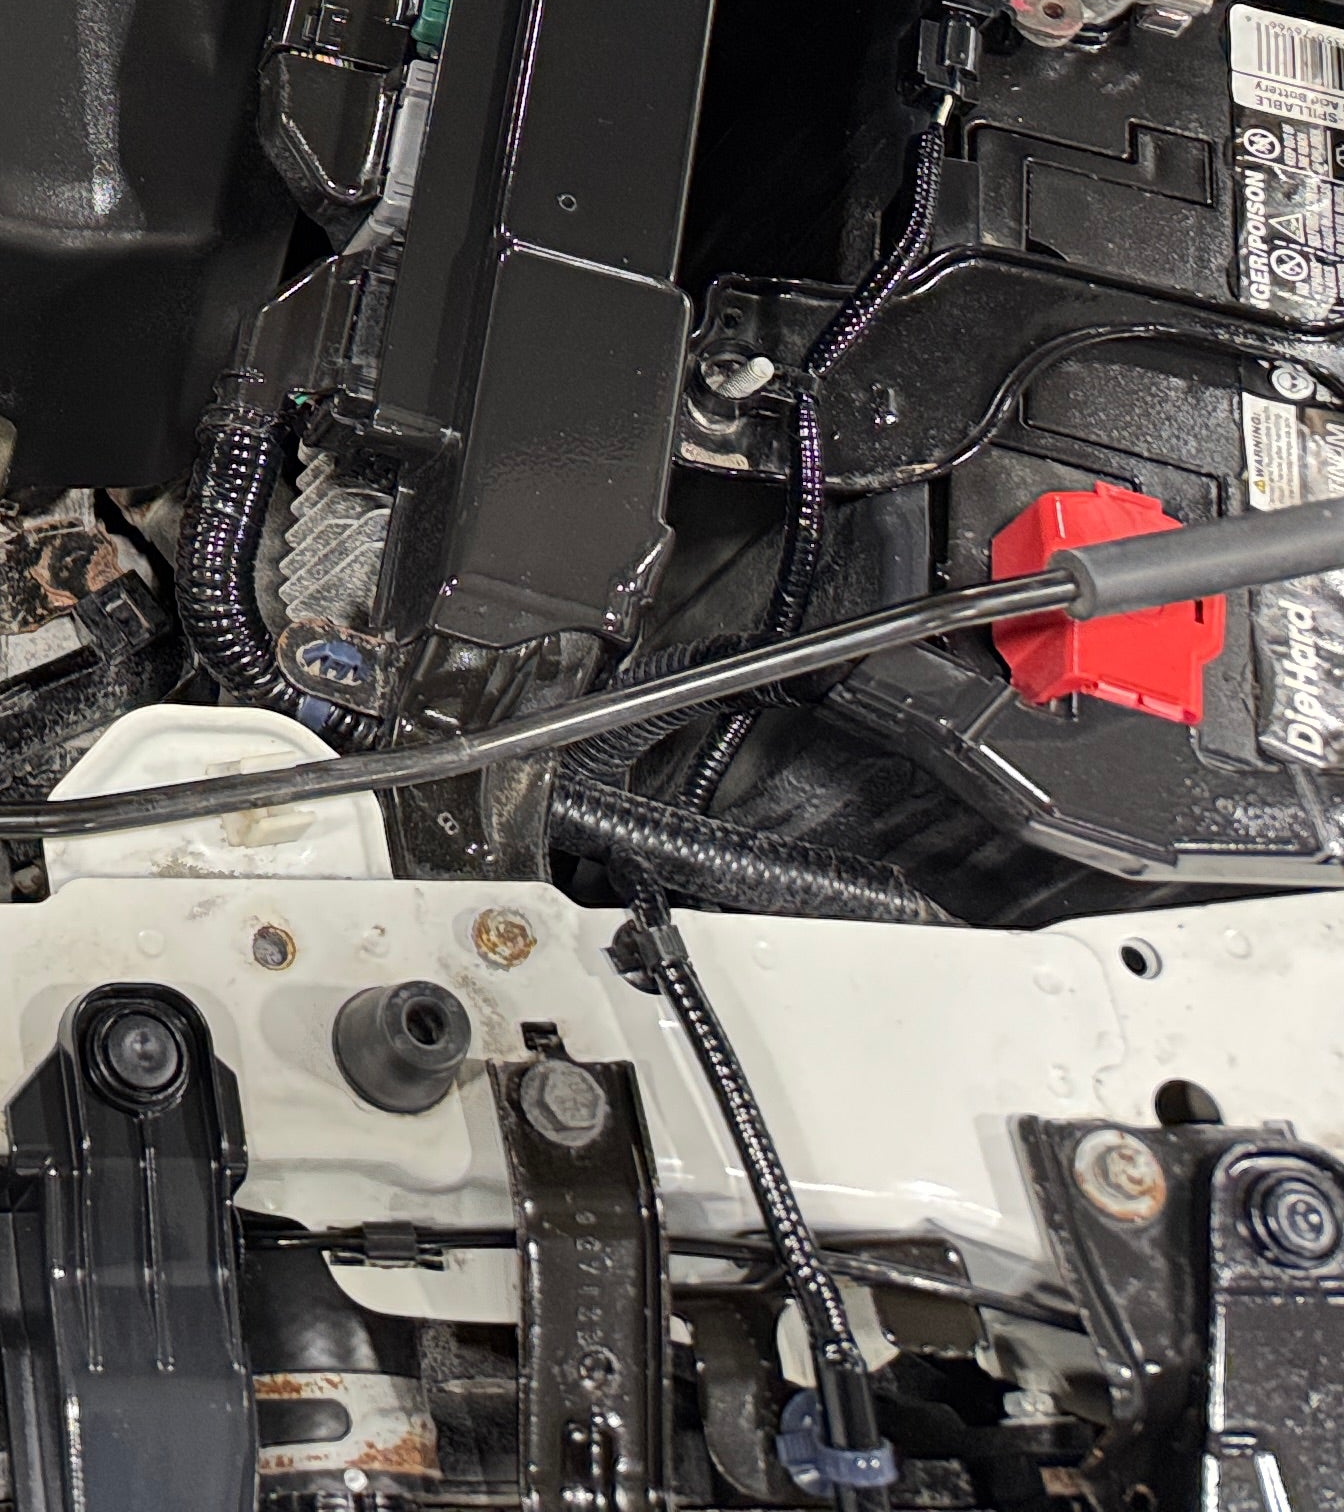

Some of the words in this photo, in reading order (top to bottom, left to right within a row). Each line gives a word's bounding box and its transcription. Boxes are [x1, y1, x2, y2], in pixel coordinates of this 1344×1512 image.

[1254, 81, 1308, 104] Battery
[1244, 168, 1271, 310] NGER/POISON
[1278, 599, 1325, 756] DieHard
